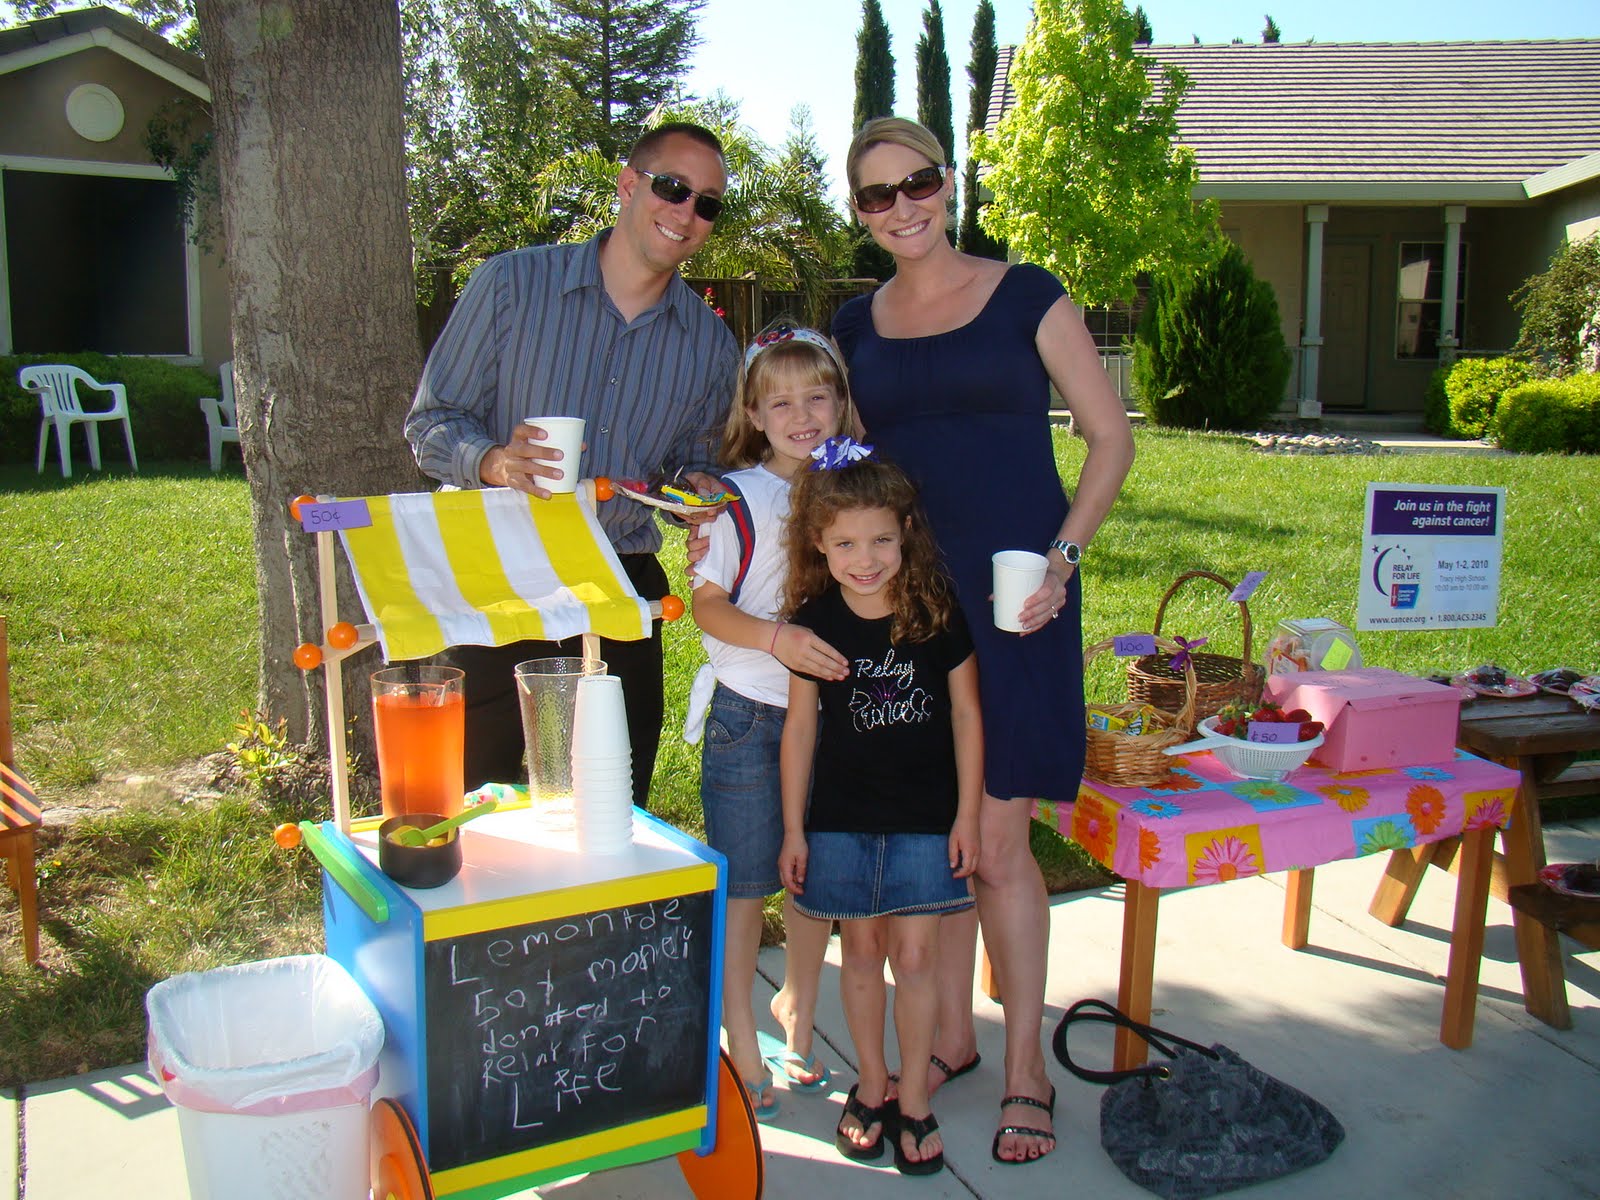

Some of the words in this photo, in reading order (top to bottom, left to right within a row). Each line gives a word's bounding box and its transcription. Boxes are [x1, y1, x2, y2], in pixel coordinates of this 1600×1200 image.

[1394, 499, 1416, 511] Join
[1418, 501, 1431, 511] us
[1433, 500, 1444, 512] in
[1446, 500, 1463, 512] the
[1466, 501, 1491, 515] fight
[311, 507, 341, 525] 50¢
[1412, 514, 1452, 529] against
[1453, 516, 1490, 527] cancer!
[1437, 560, 1454, 571] May
[1471, 559, 1489, 569] 2010
[1392, 572, 1405, 580] FOR
[1407, 572, 1420, 580] LIFE
[1369, 616, 1426, 625] www.cancer.org
[1438, 613, 1487, 622] 1.800.ACS.2345
[1120, 641, 1144, 652] 1.00
[855, 648, 915, 690] Relay
[630, 984, 672, 1007] to
